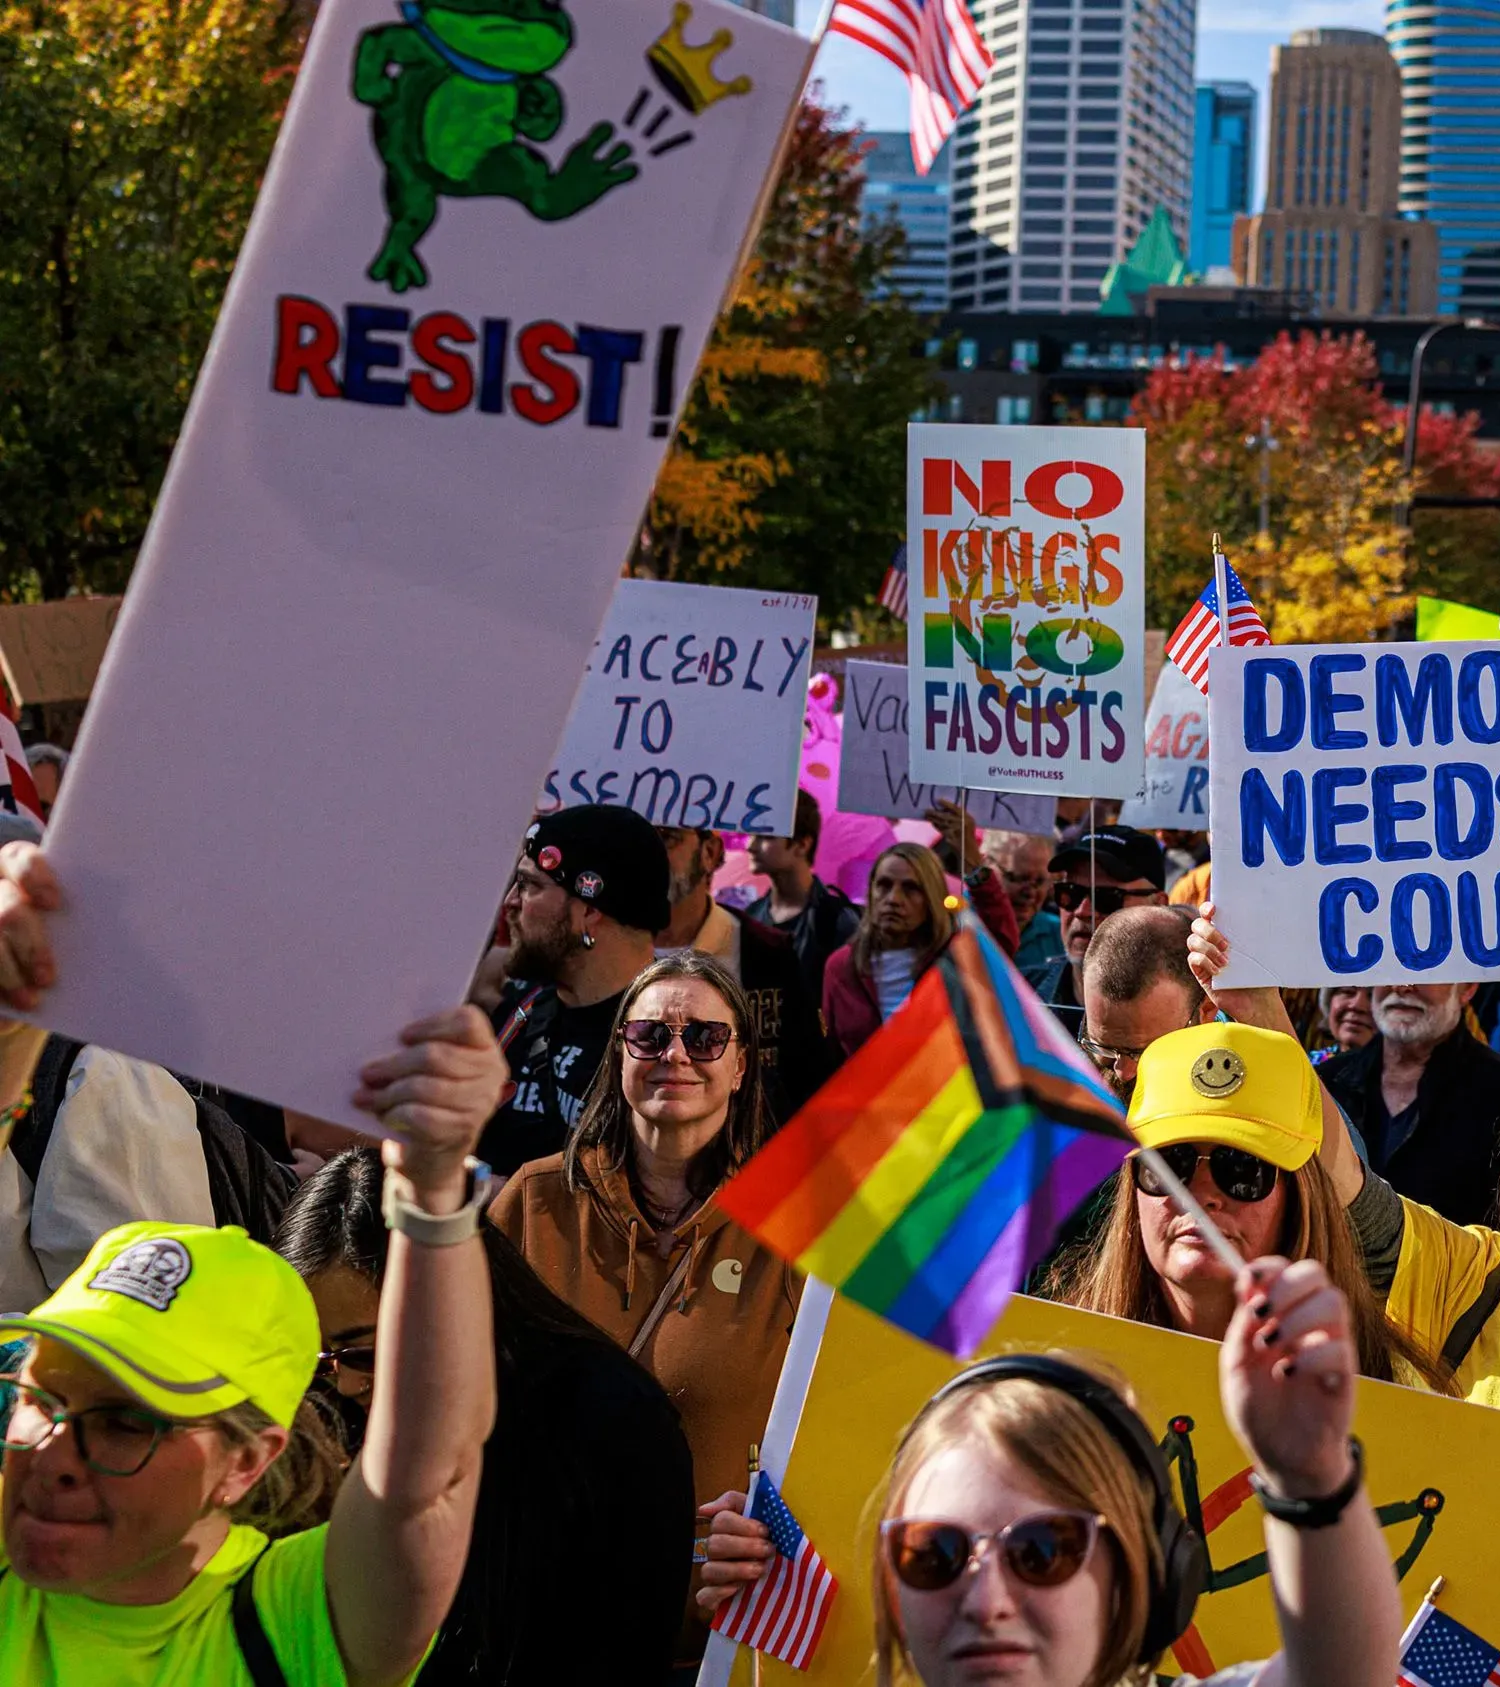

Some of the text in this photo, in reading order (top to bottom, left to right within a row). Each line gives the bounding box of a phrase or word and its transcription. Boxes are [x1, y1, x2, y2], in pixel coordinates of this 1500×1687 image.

[272, 295, 682, 438] RESIST!
[923, 458, 1124, 520] NO
[923, 529, 1124, 607] KINGS
[585, 634, 809, 697] ACEABLY
[924, 612, 1124, 676] NO
[614, 696, 673, 754] TO
[925, 681, 1126, 763] FASCISTS
[535, 767, 774, 833] SSEMBLE
